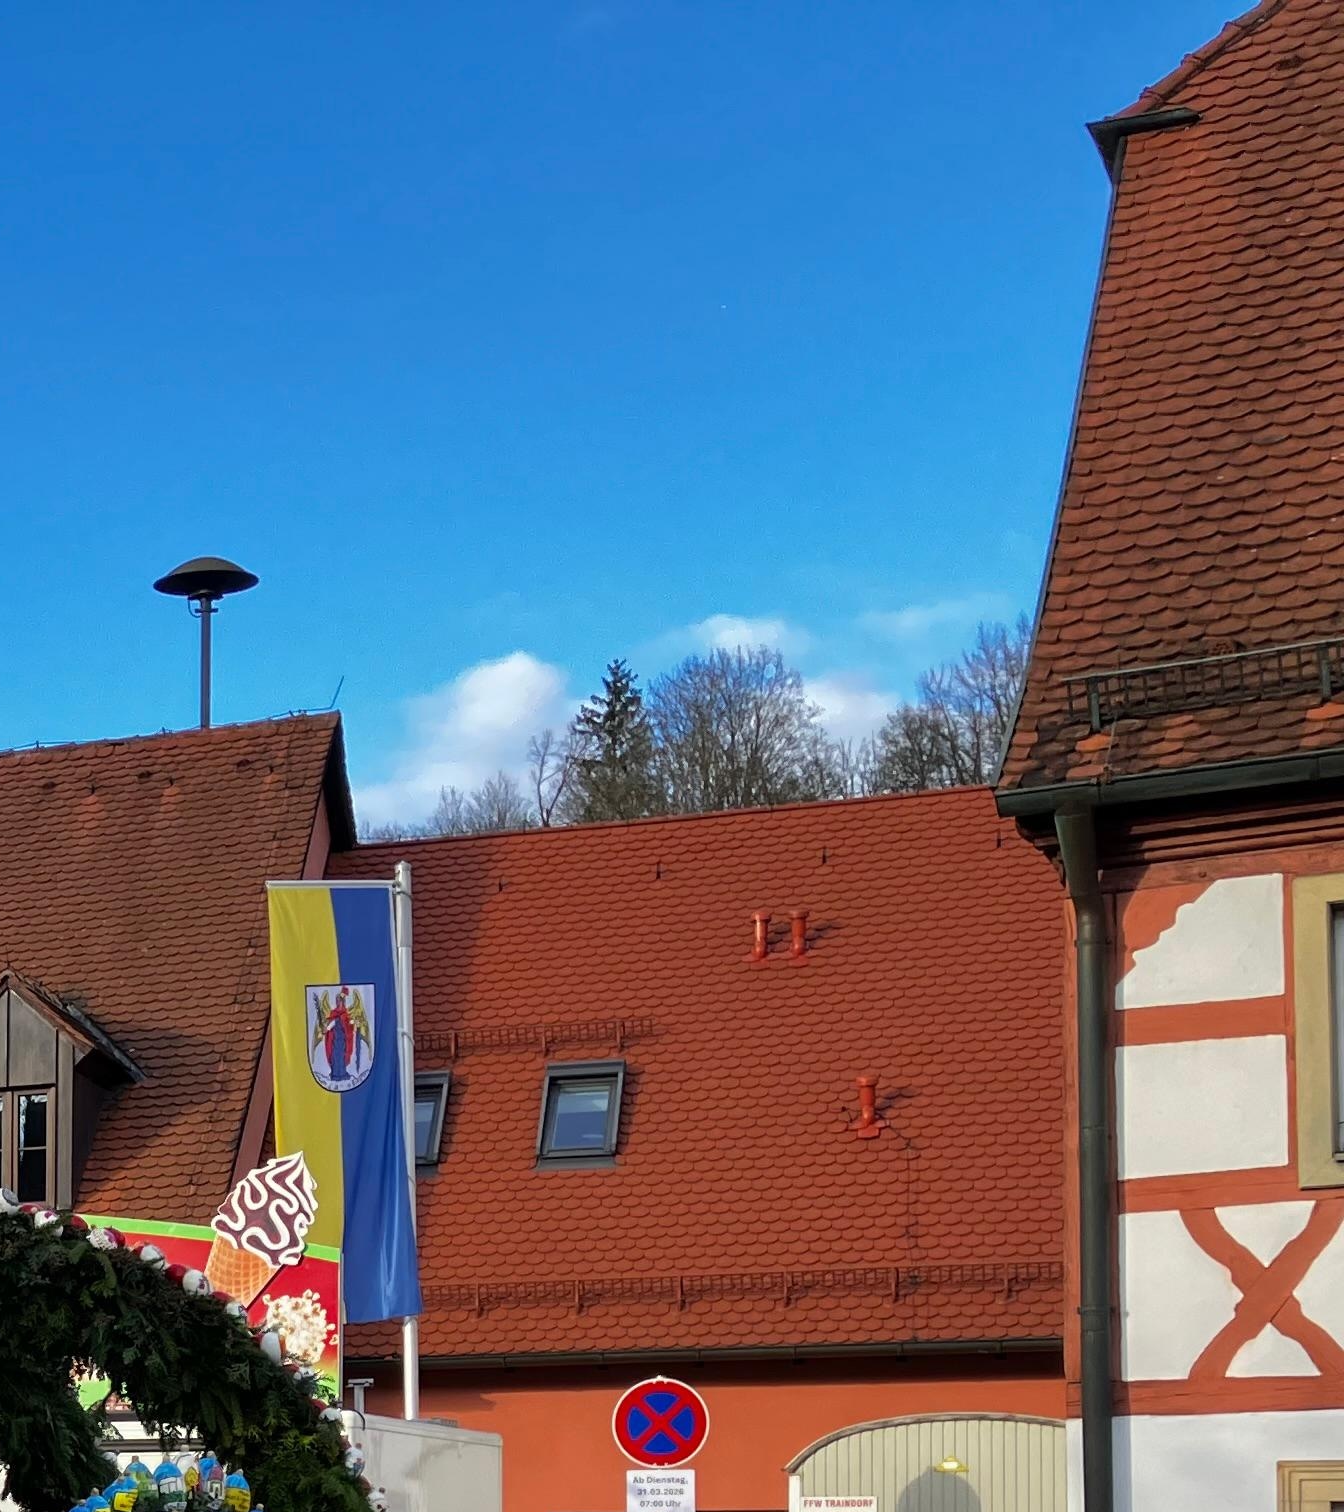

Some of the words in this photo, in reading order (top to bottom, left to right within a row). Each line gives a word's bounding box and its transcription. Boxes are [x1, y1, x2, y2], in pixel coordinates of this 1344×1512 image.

[633, 1476, 645, 1484] Ab
[665, 1500, 682, 1508] Uhr
[803, 1499, 823, 1508] FFW
[825, 1498, 874, 1508] TRAINDORF
